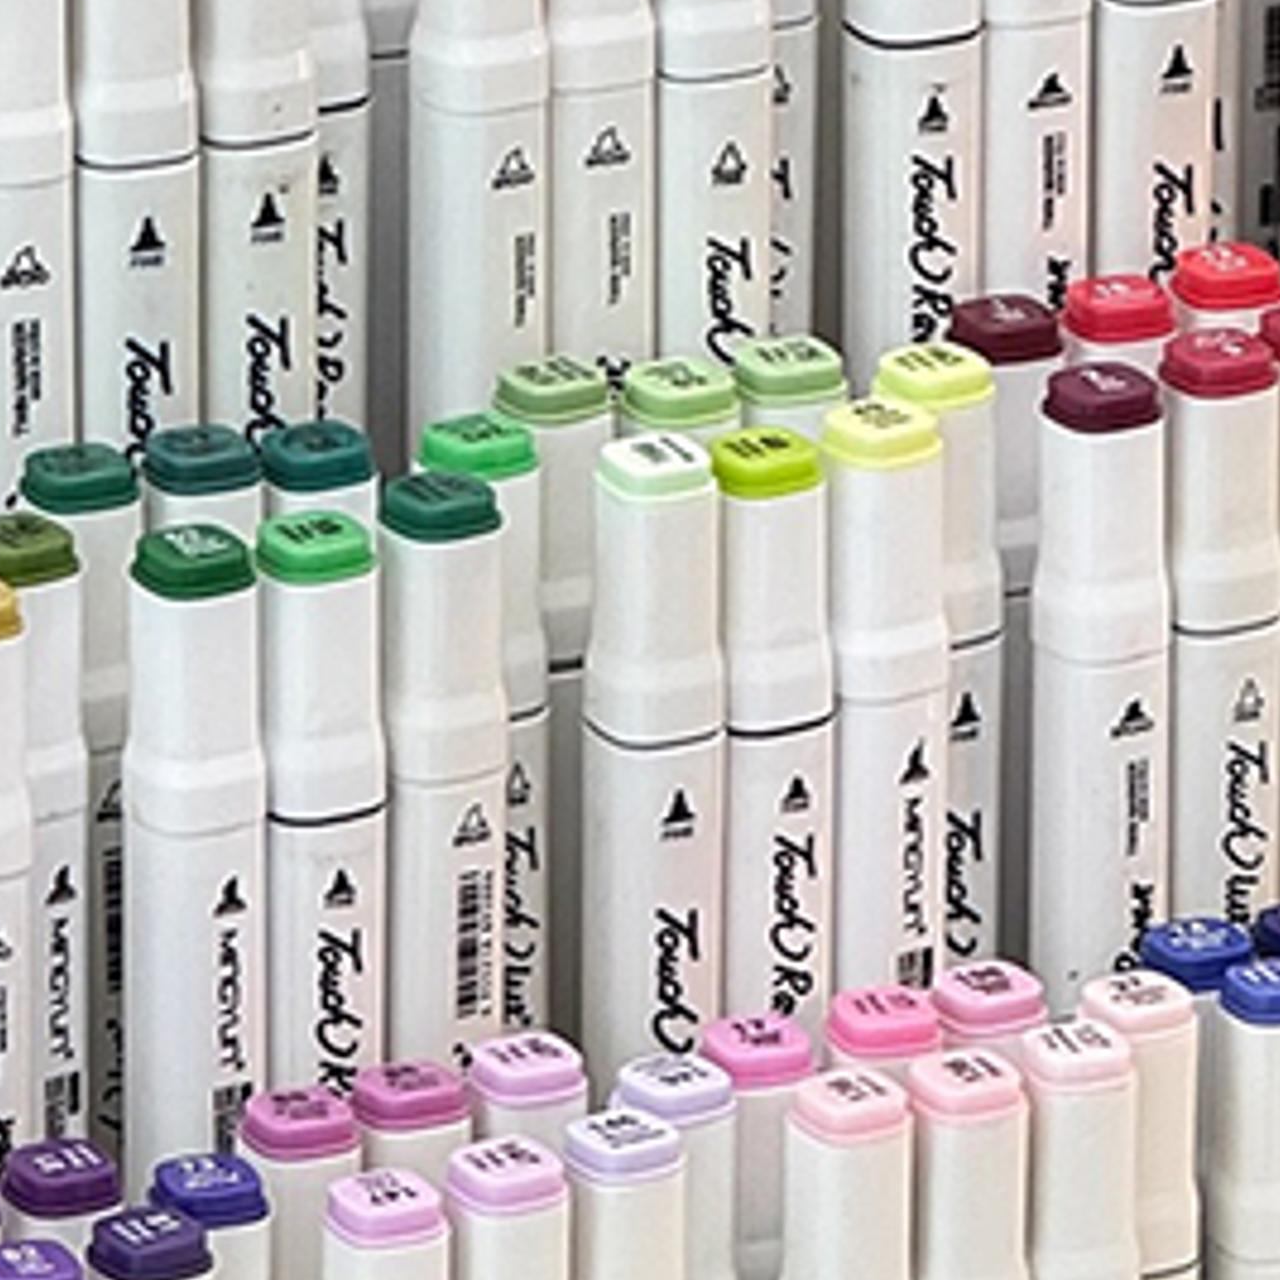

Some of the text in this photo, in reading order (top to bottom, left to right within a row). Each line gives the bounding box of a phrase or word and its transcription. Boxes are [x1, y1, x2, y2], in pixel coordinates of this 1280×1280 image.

[907, 153, 958, 283] Touch
[1223, 740, 1271, 874] Touch
[769, 833, 819, 964] Touch
[945, 810, 984, 958] Touch
[315, 926, 365, 1060] Touch
[652, 906, 701, 1054] Touch
